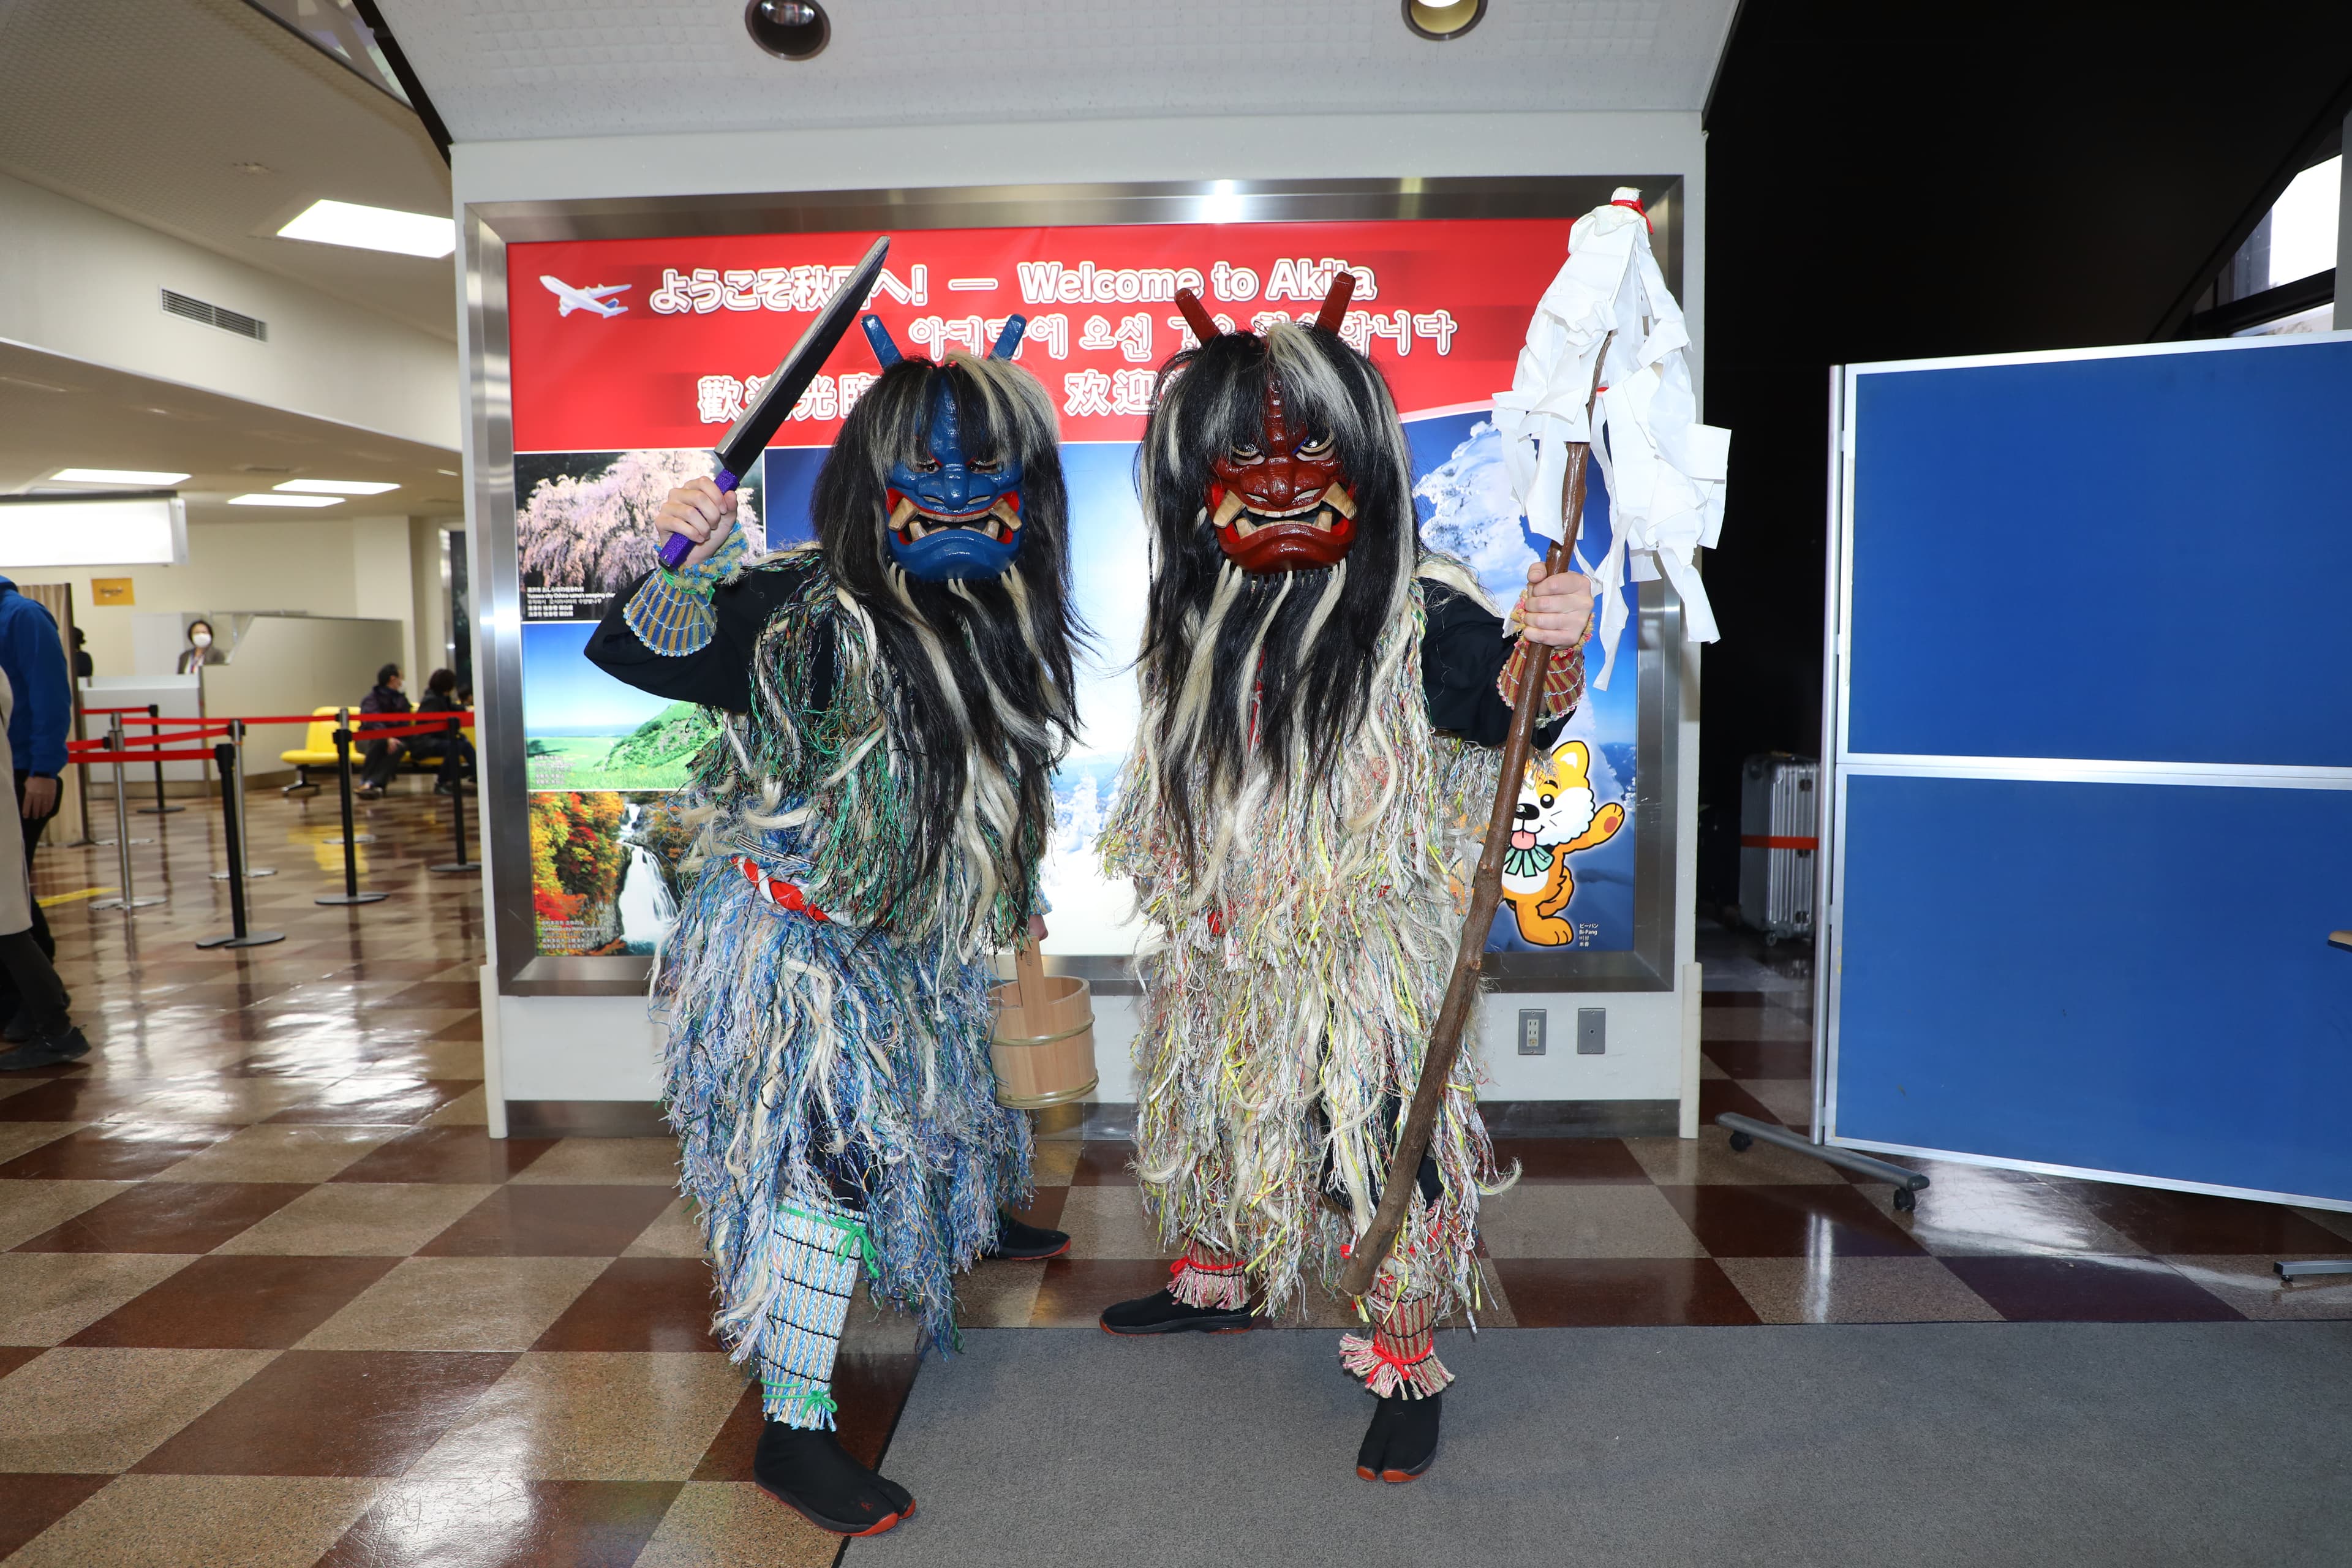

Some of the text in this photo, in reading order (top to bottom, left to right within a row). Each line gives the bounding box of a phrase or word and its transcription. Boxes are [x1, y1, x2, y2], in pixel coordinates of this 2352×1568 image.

[1017, 261, 1204, 304] Welcome
[1212, 261, 1259, 303] to
[1079, 312, 1152, 363] 오신
[697, 372, 878, 424] 歡光
